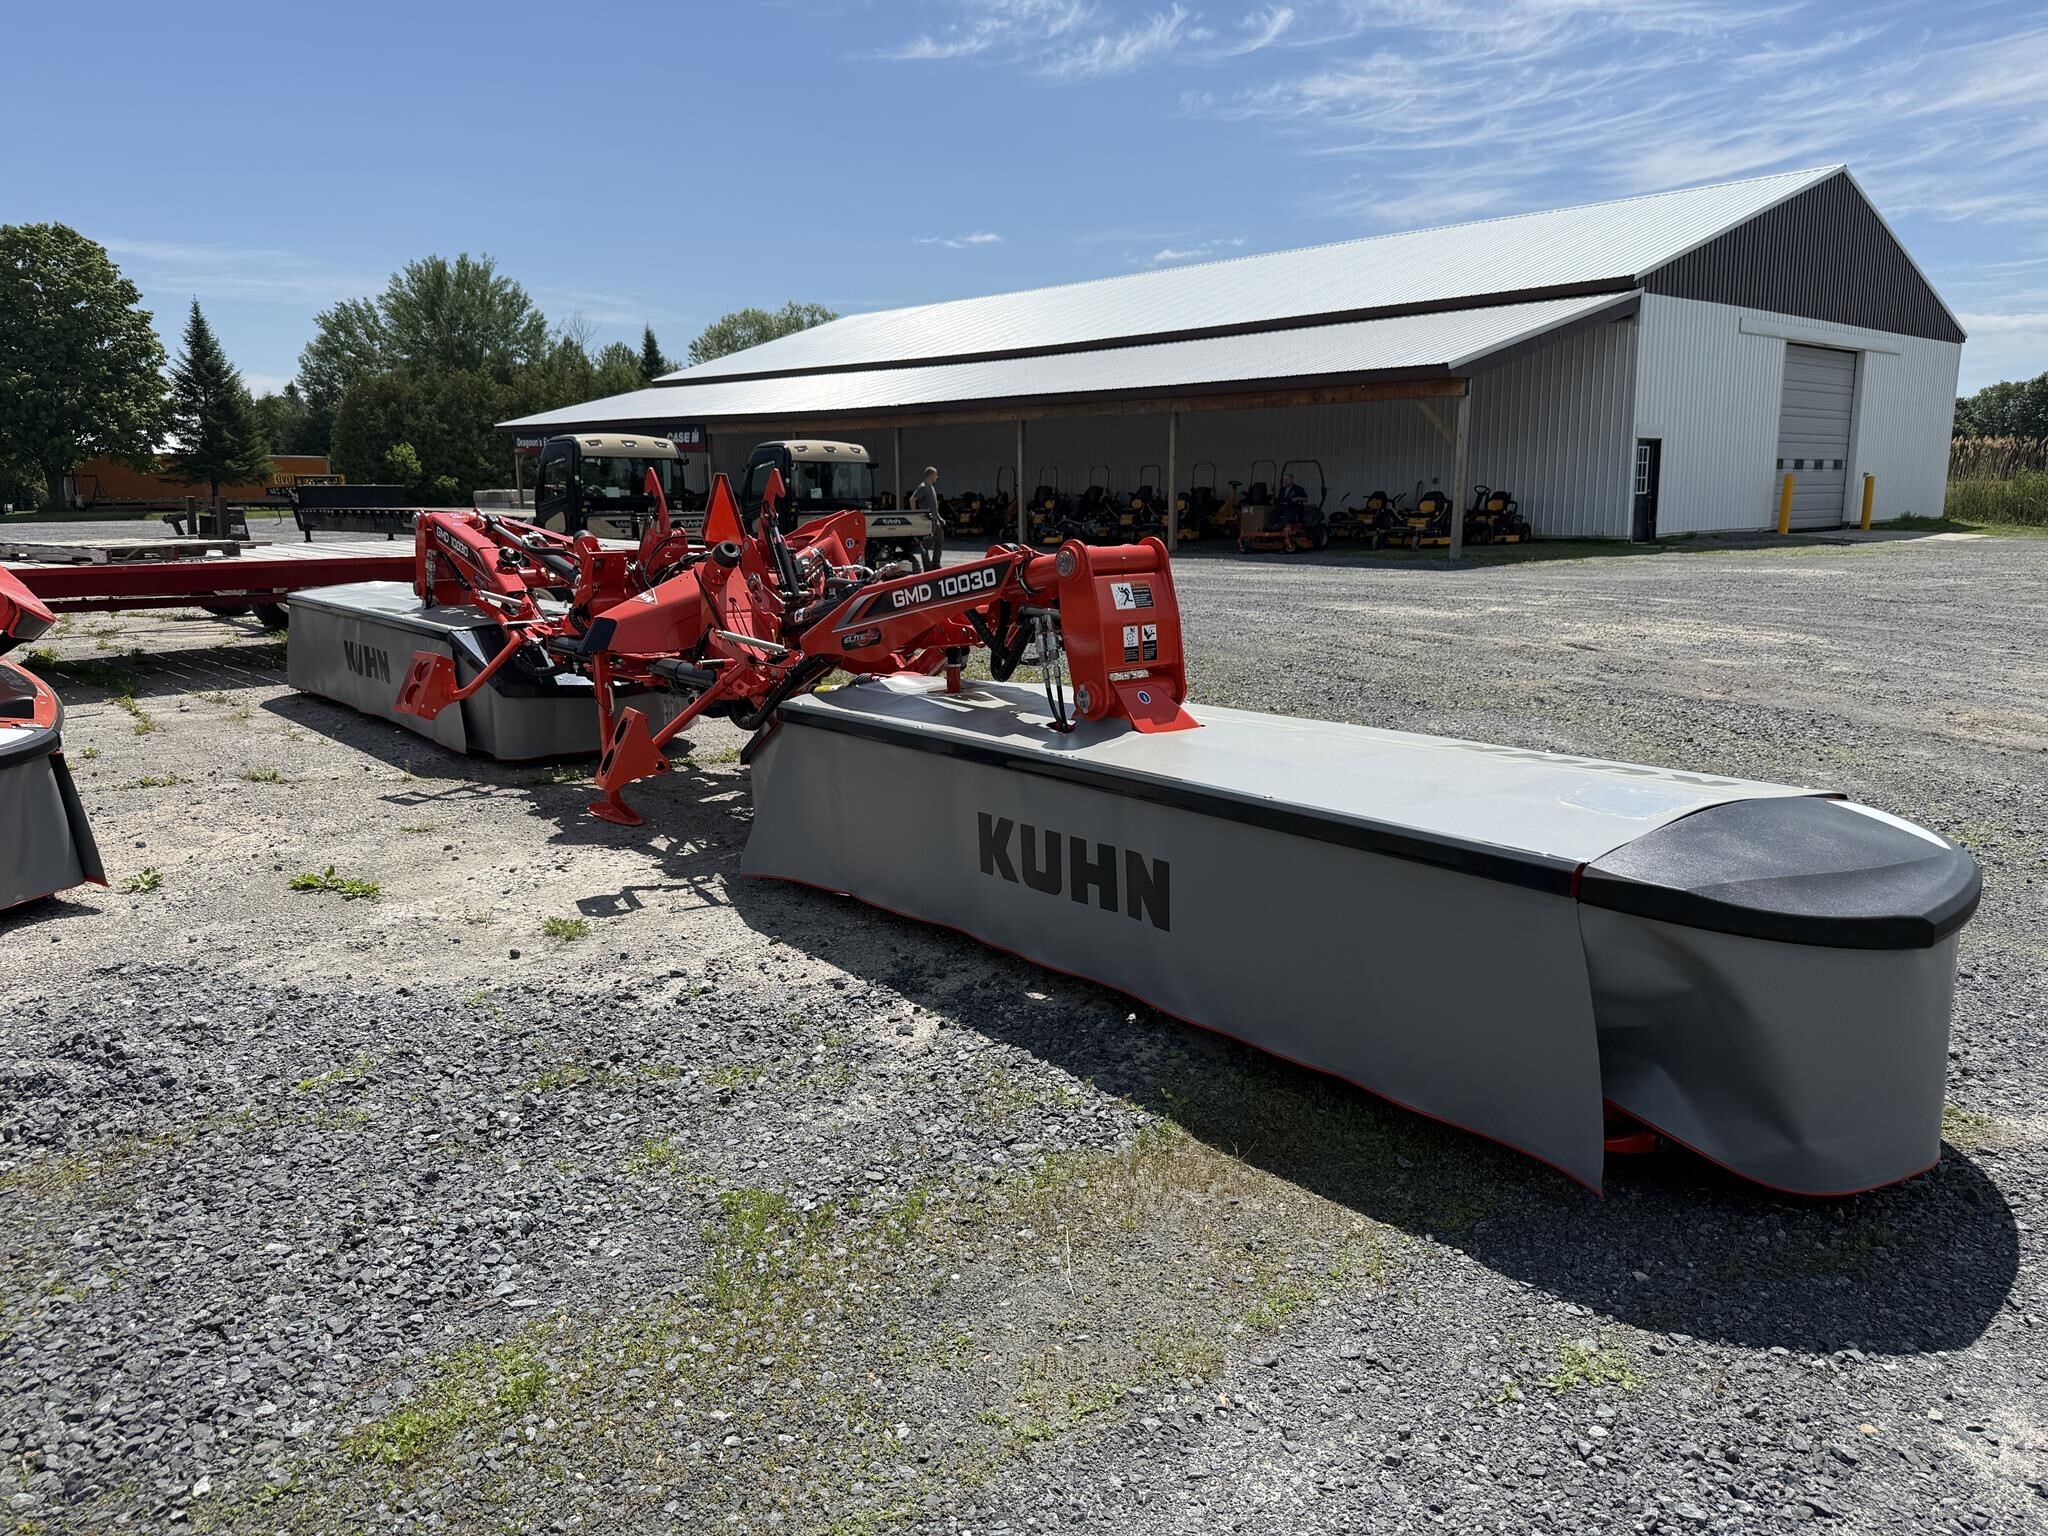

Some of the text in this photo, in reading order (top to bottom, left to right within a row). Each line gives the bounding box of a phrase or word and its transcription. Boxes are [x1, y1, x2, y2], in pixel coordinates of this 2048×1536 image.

[516, 436, 543, 448] Dragoon's
[667, 431, 690, 443] CASE
[436, 526, 469, 558] GMD 10030
[892, 568, 997, 608] GMD 10030
[844, 633, 866, 644] ELITE
[343, 640, 391, 684] KUHN
[977, 811, 1170, 932] KUHN
